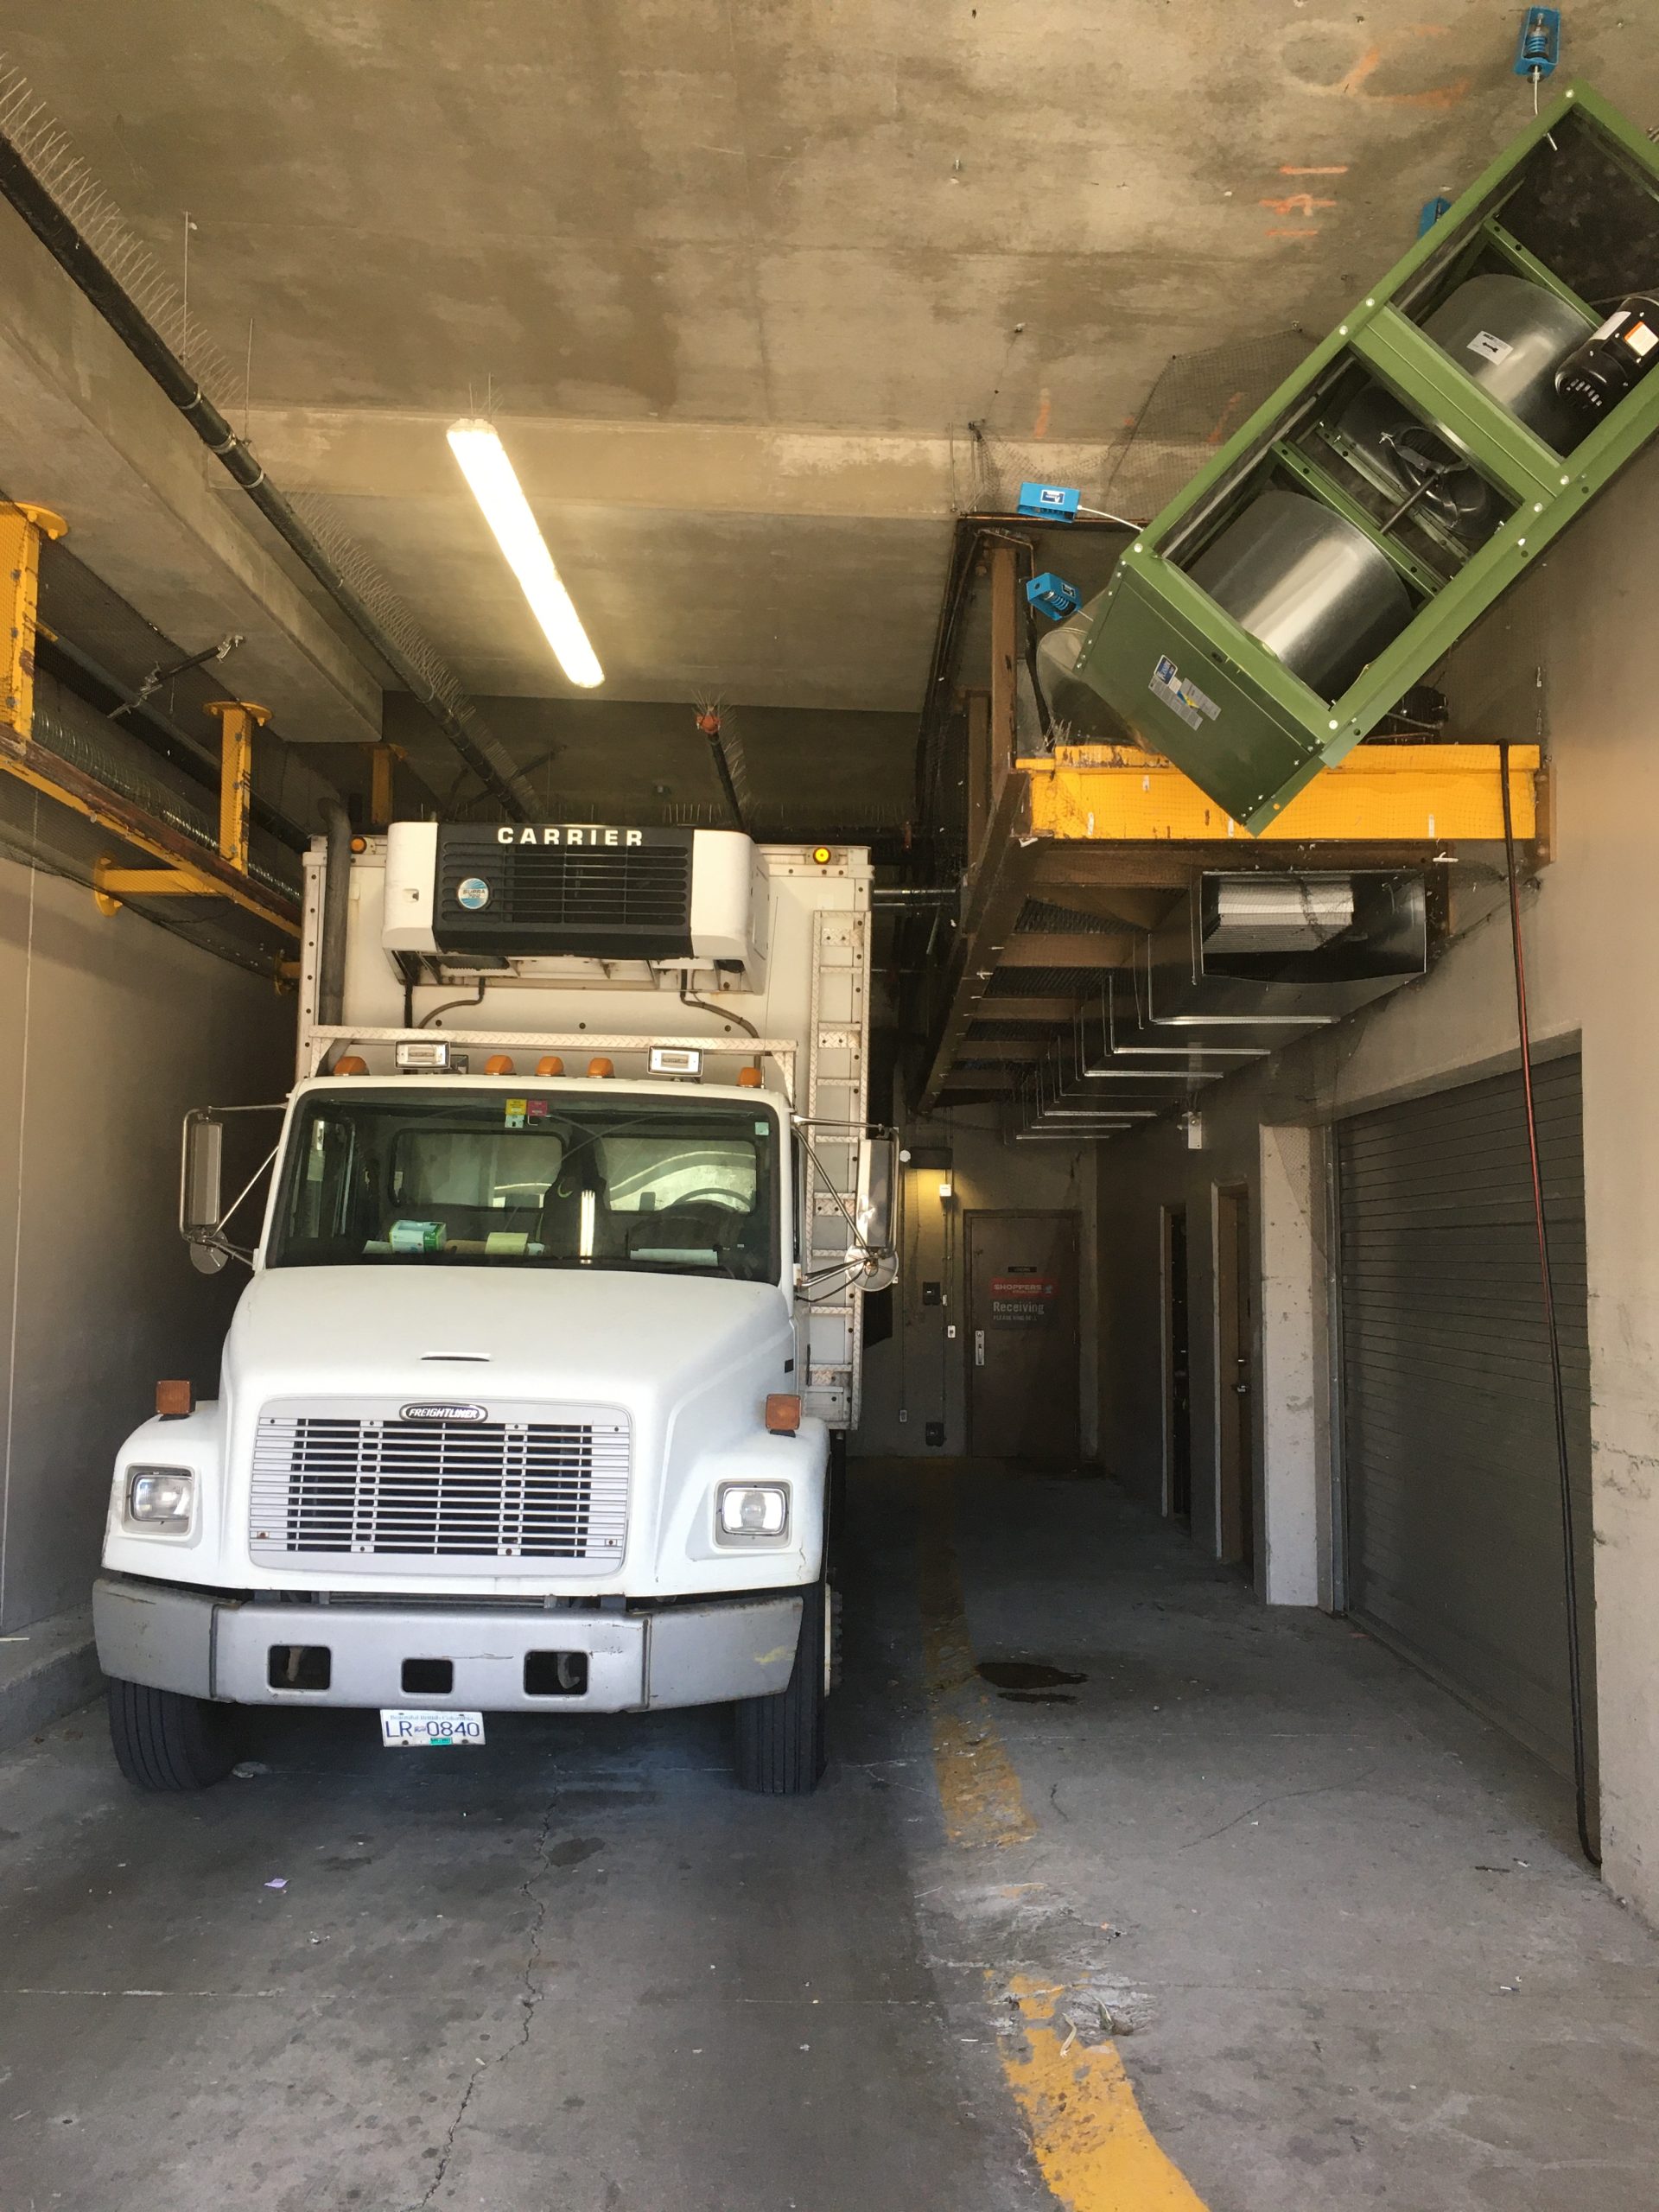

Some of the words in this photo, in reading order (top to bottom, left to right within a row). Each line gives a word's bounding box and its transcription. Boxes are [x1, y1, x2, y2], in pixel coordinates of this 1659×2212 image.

[498, 827, 643, 846] CARRIER
[993, 1301, 1045, 1314] Receiving
[408, 1408, 478, 1418] FREIGHTLINER
[386, 1721, 413, 1738] LR
[427, 1721, 480, 1737] 0840
